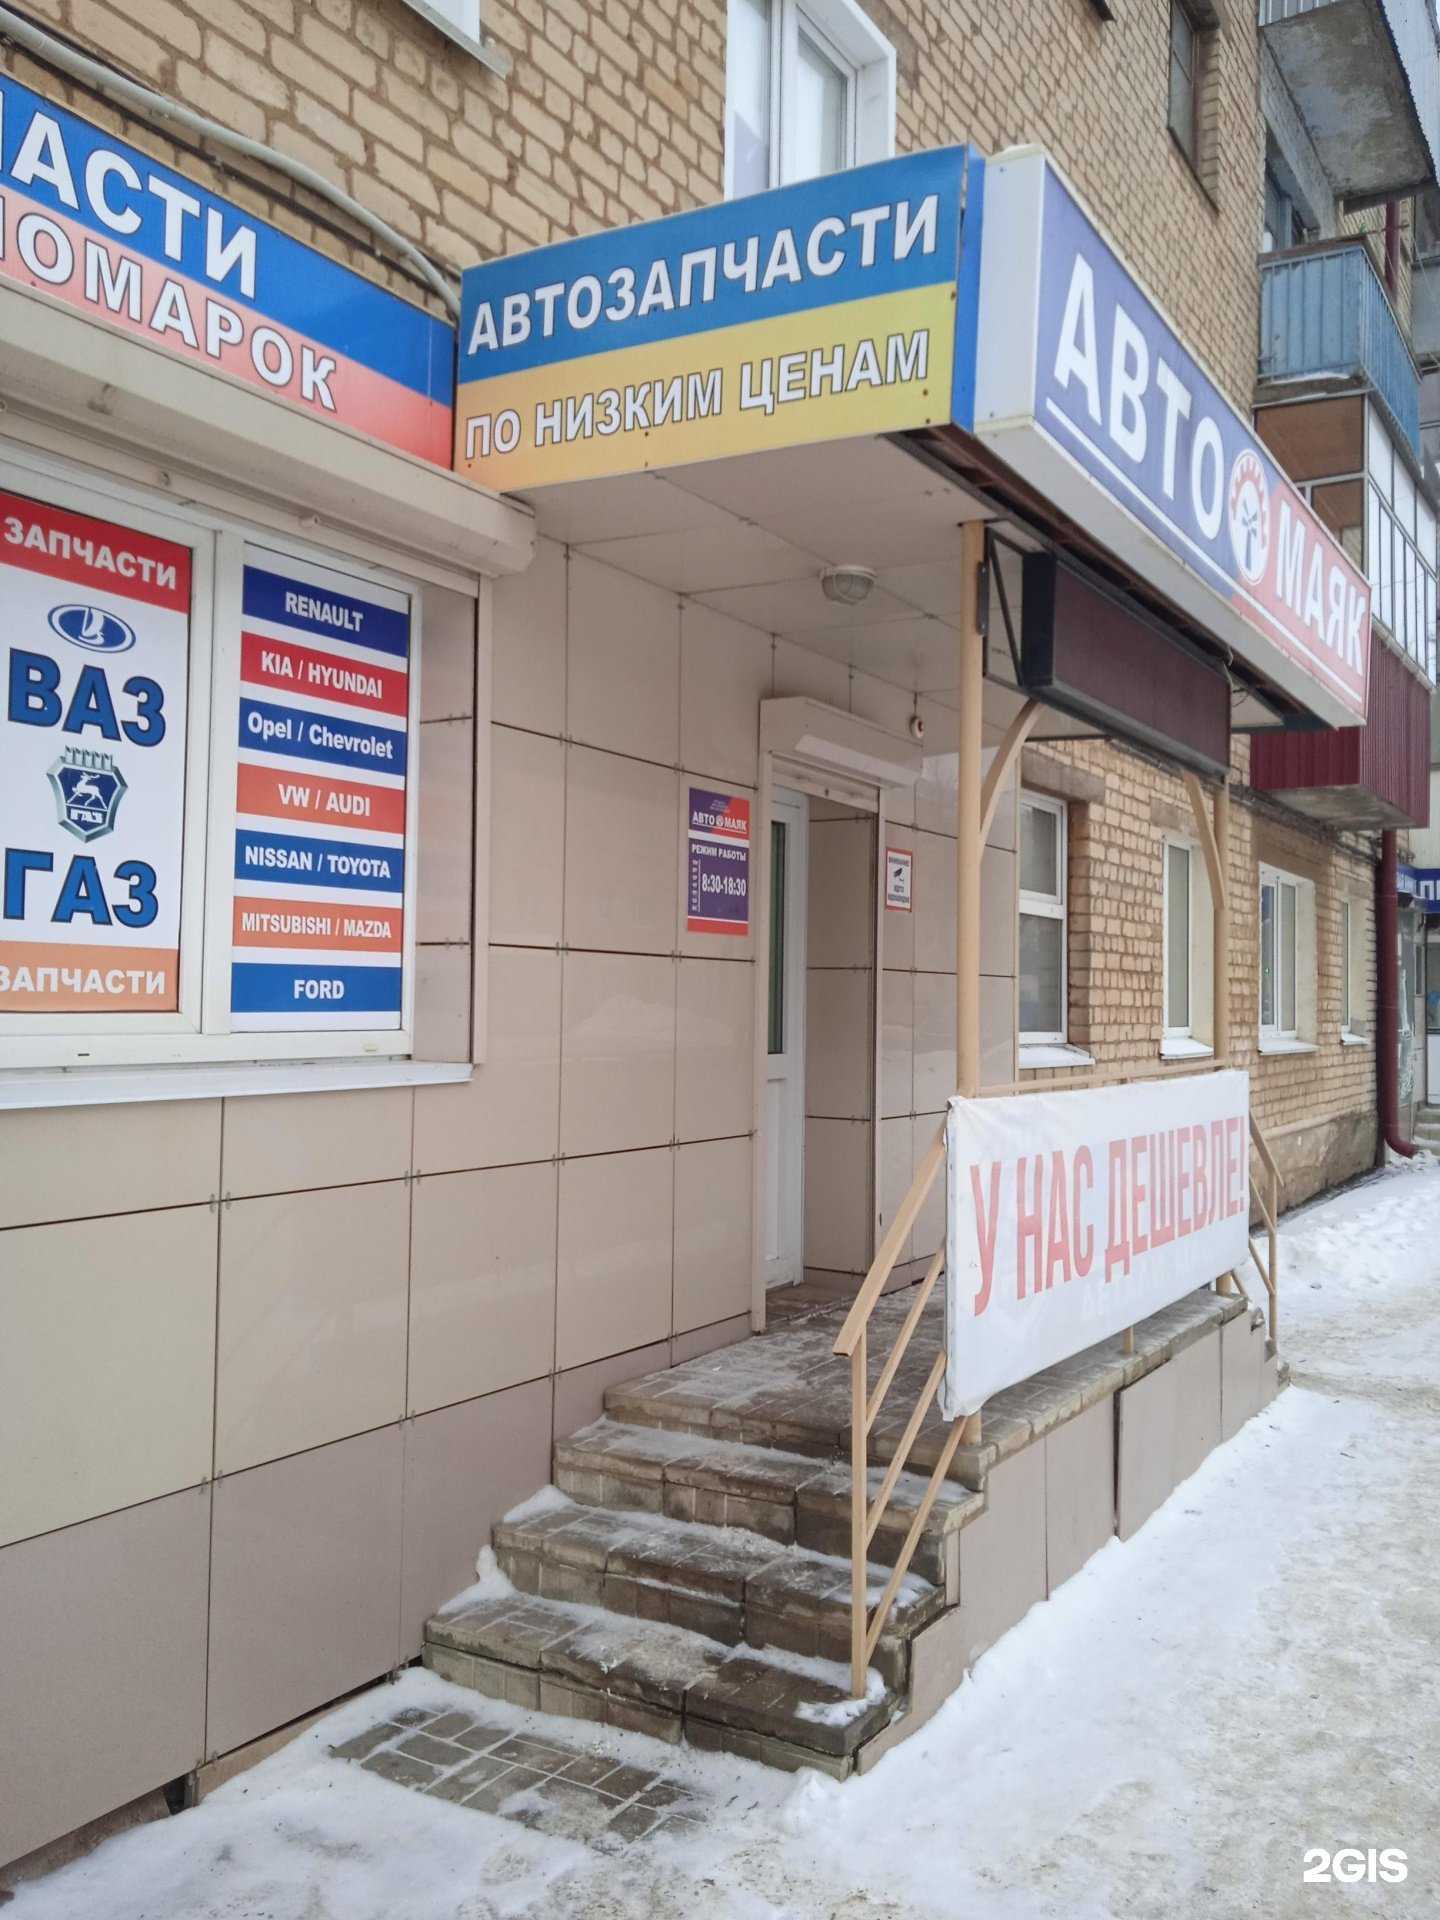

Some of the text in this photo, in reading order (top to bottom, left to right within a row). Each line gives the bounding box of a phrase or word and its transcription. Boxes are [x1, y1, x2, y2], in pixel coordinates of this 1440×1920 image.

[0, 91, 257, 300] АСТИ
[466, 195, 939, 356] АВТОЗАПЧАСТИ
[0, 196, 337, 412] ОМАРОК
[465, 328, 929, 460] ПО НИЗКИМ ЦЕНАМ
[1054, 252, 1366, 675] АВТО МАЯК
[4, 517, 176, 590] ЗАПЧАСТИ
[285, 591, 363, 633] RENAULT
[8, 647, 166, 748] ВАЗ
[261, 651, 293, 680] KIA
[308, 662, 383, 699] HYUNDAI
[247, 711, 292, 741] Opel
[309, 724, 393, 760] Chevrolet
[279, 784, 310, 808] VW
[326, 794, 370, 817] AUDI
[692, 811, 747, 831] АВТО МАЯК
[245, 845, 312, 871] NISSAN
[327, 854, 391, 879] TOYOTA
[691, 844, 746, 862] РЕЖИМ РАБОТЫ
[3, 847, 159, 929] ГАЗ
[702, 873, 747, 897] 8:30-18:30
[242, 911, 331, 937] MITSUBISHI
[343, 918, 391, 940] MAZDA
[293, 979, 344, 999] FORD
[969, 1115, 1245, 1317] У НАС ДЕШЕВЛЕ!
